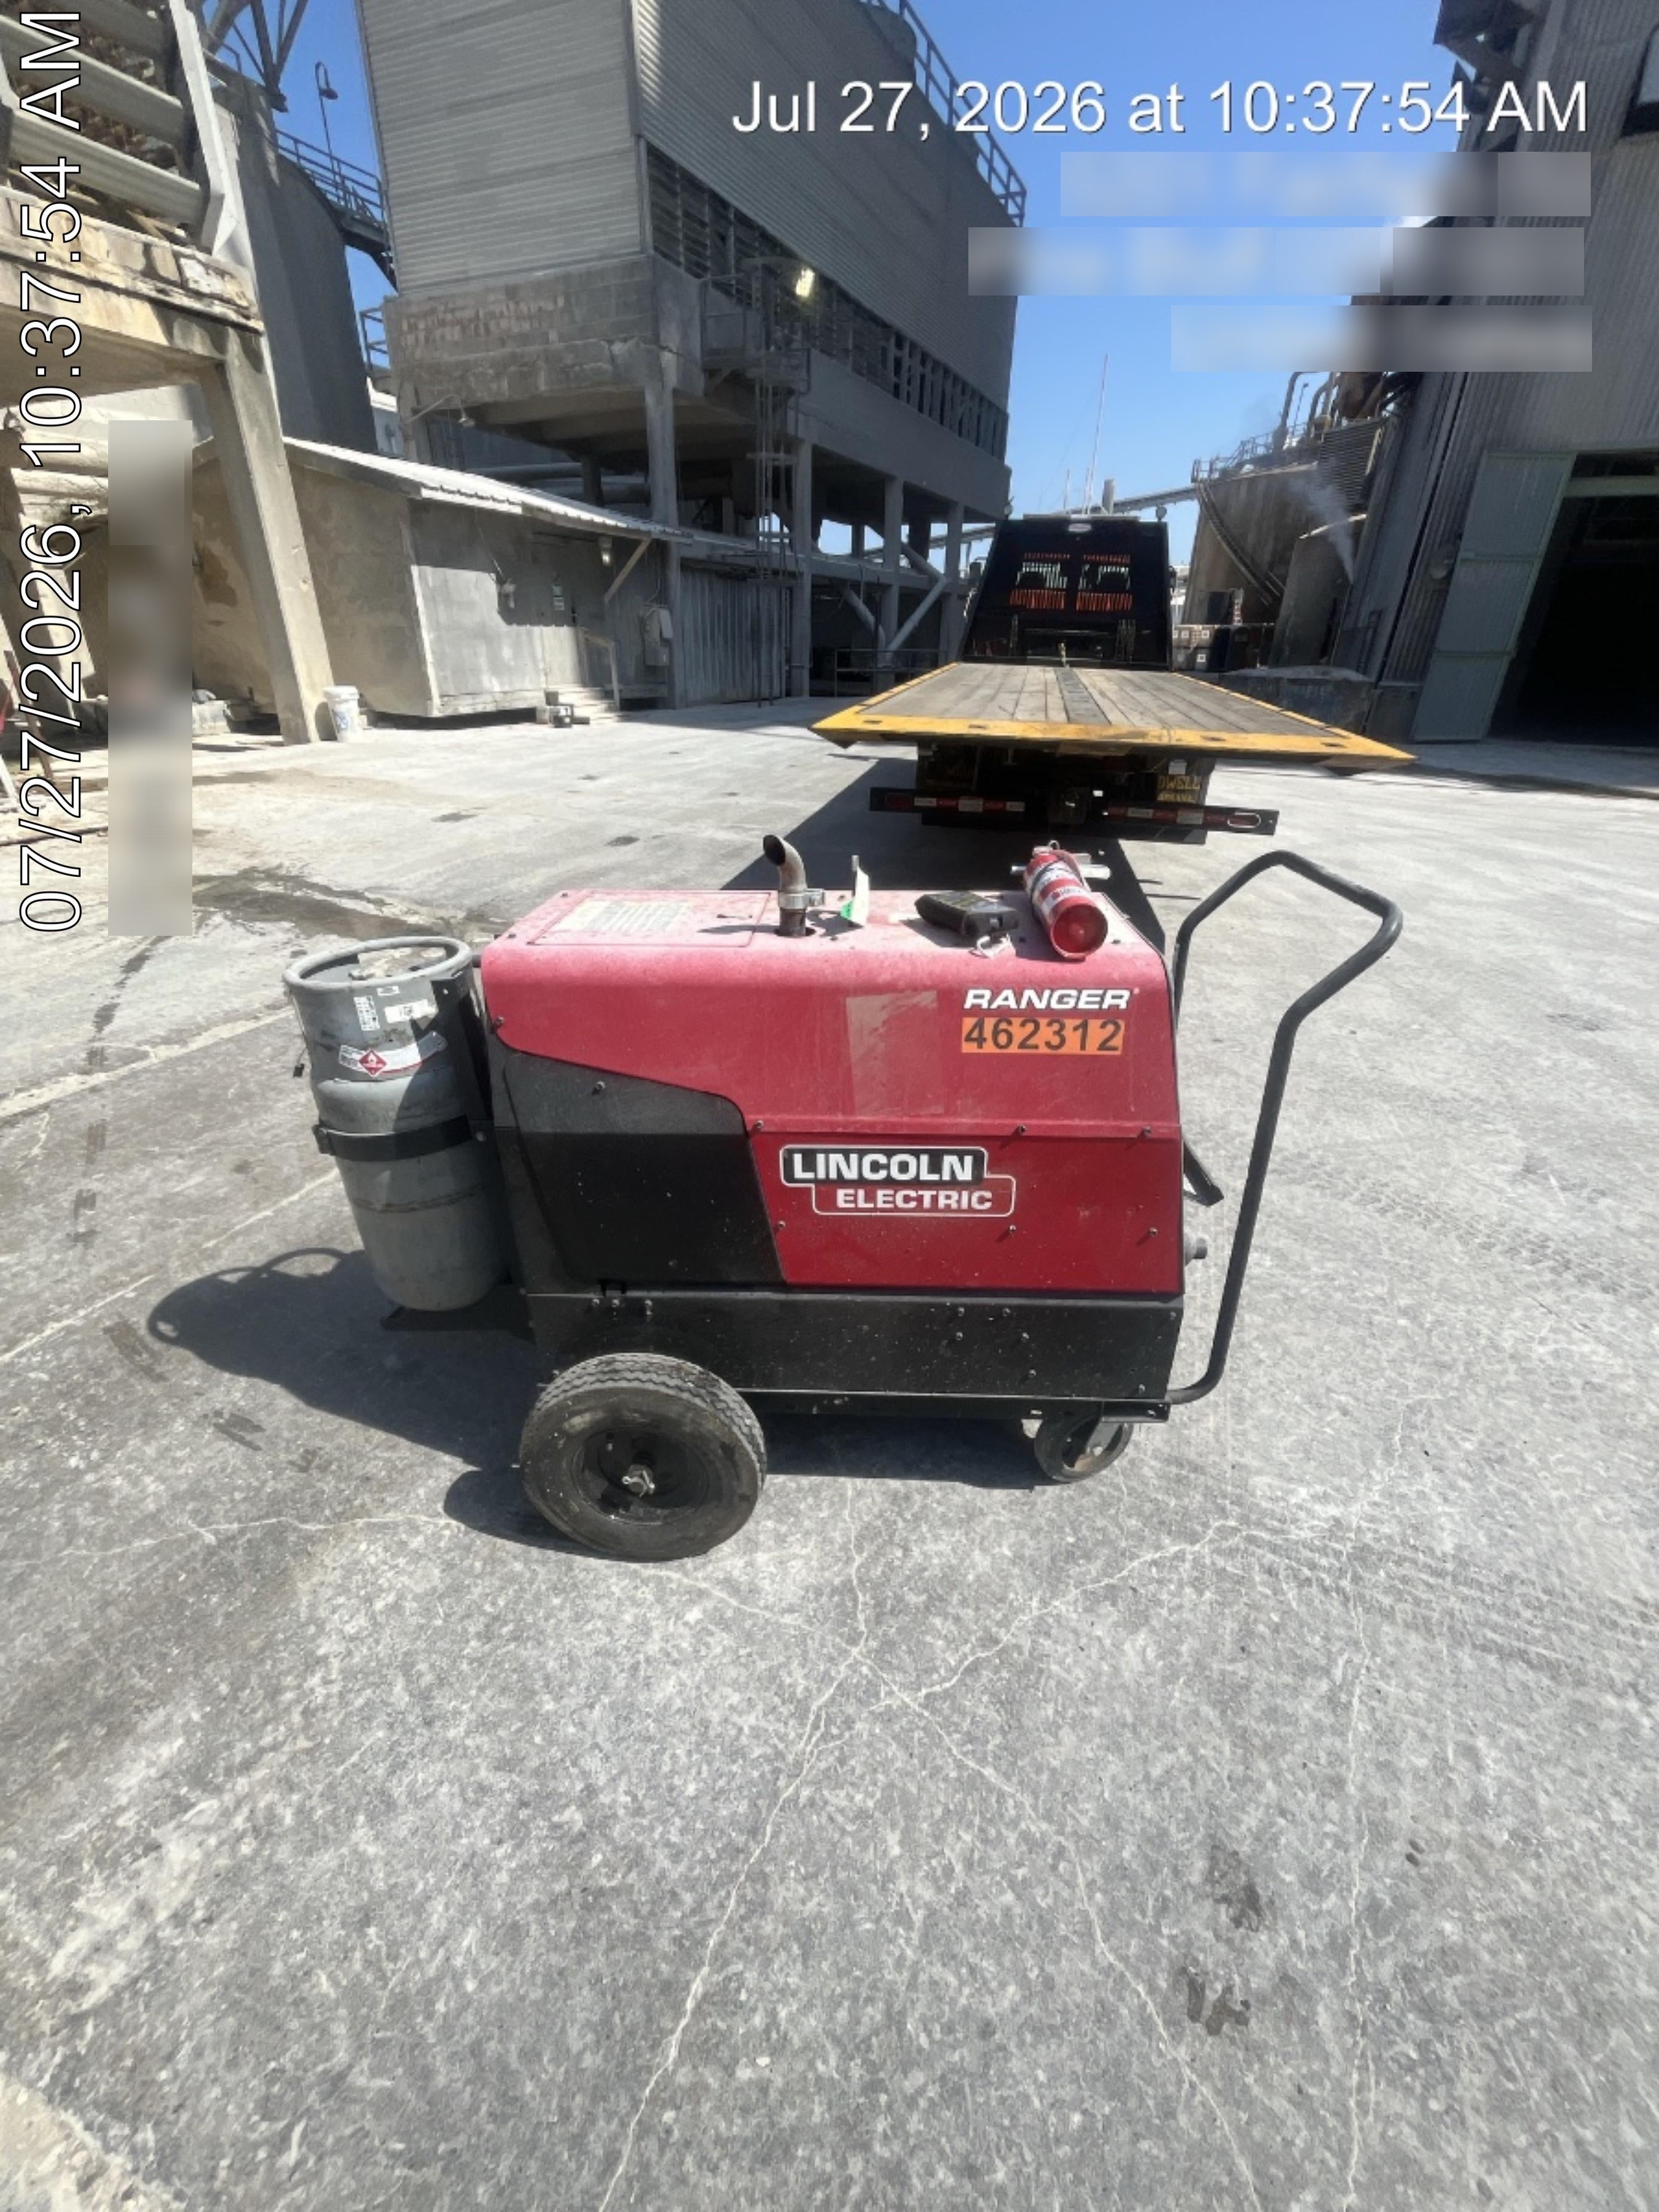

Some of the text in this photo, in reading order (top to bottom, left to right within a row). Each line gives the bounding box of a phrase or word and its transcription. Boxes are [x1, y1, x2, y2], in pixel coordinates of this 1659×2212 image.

[963, 989, 1131, 1010] RANGER
[964, 1018, 1121, 1051] 462312
[793, 1153, 973, 1181] LINCOLN
[836, 1188, 993, 1210] ELECTRIC
